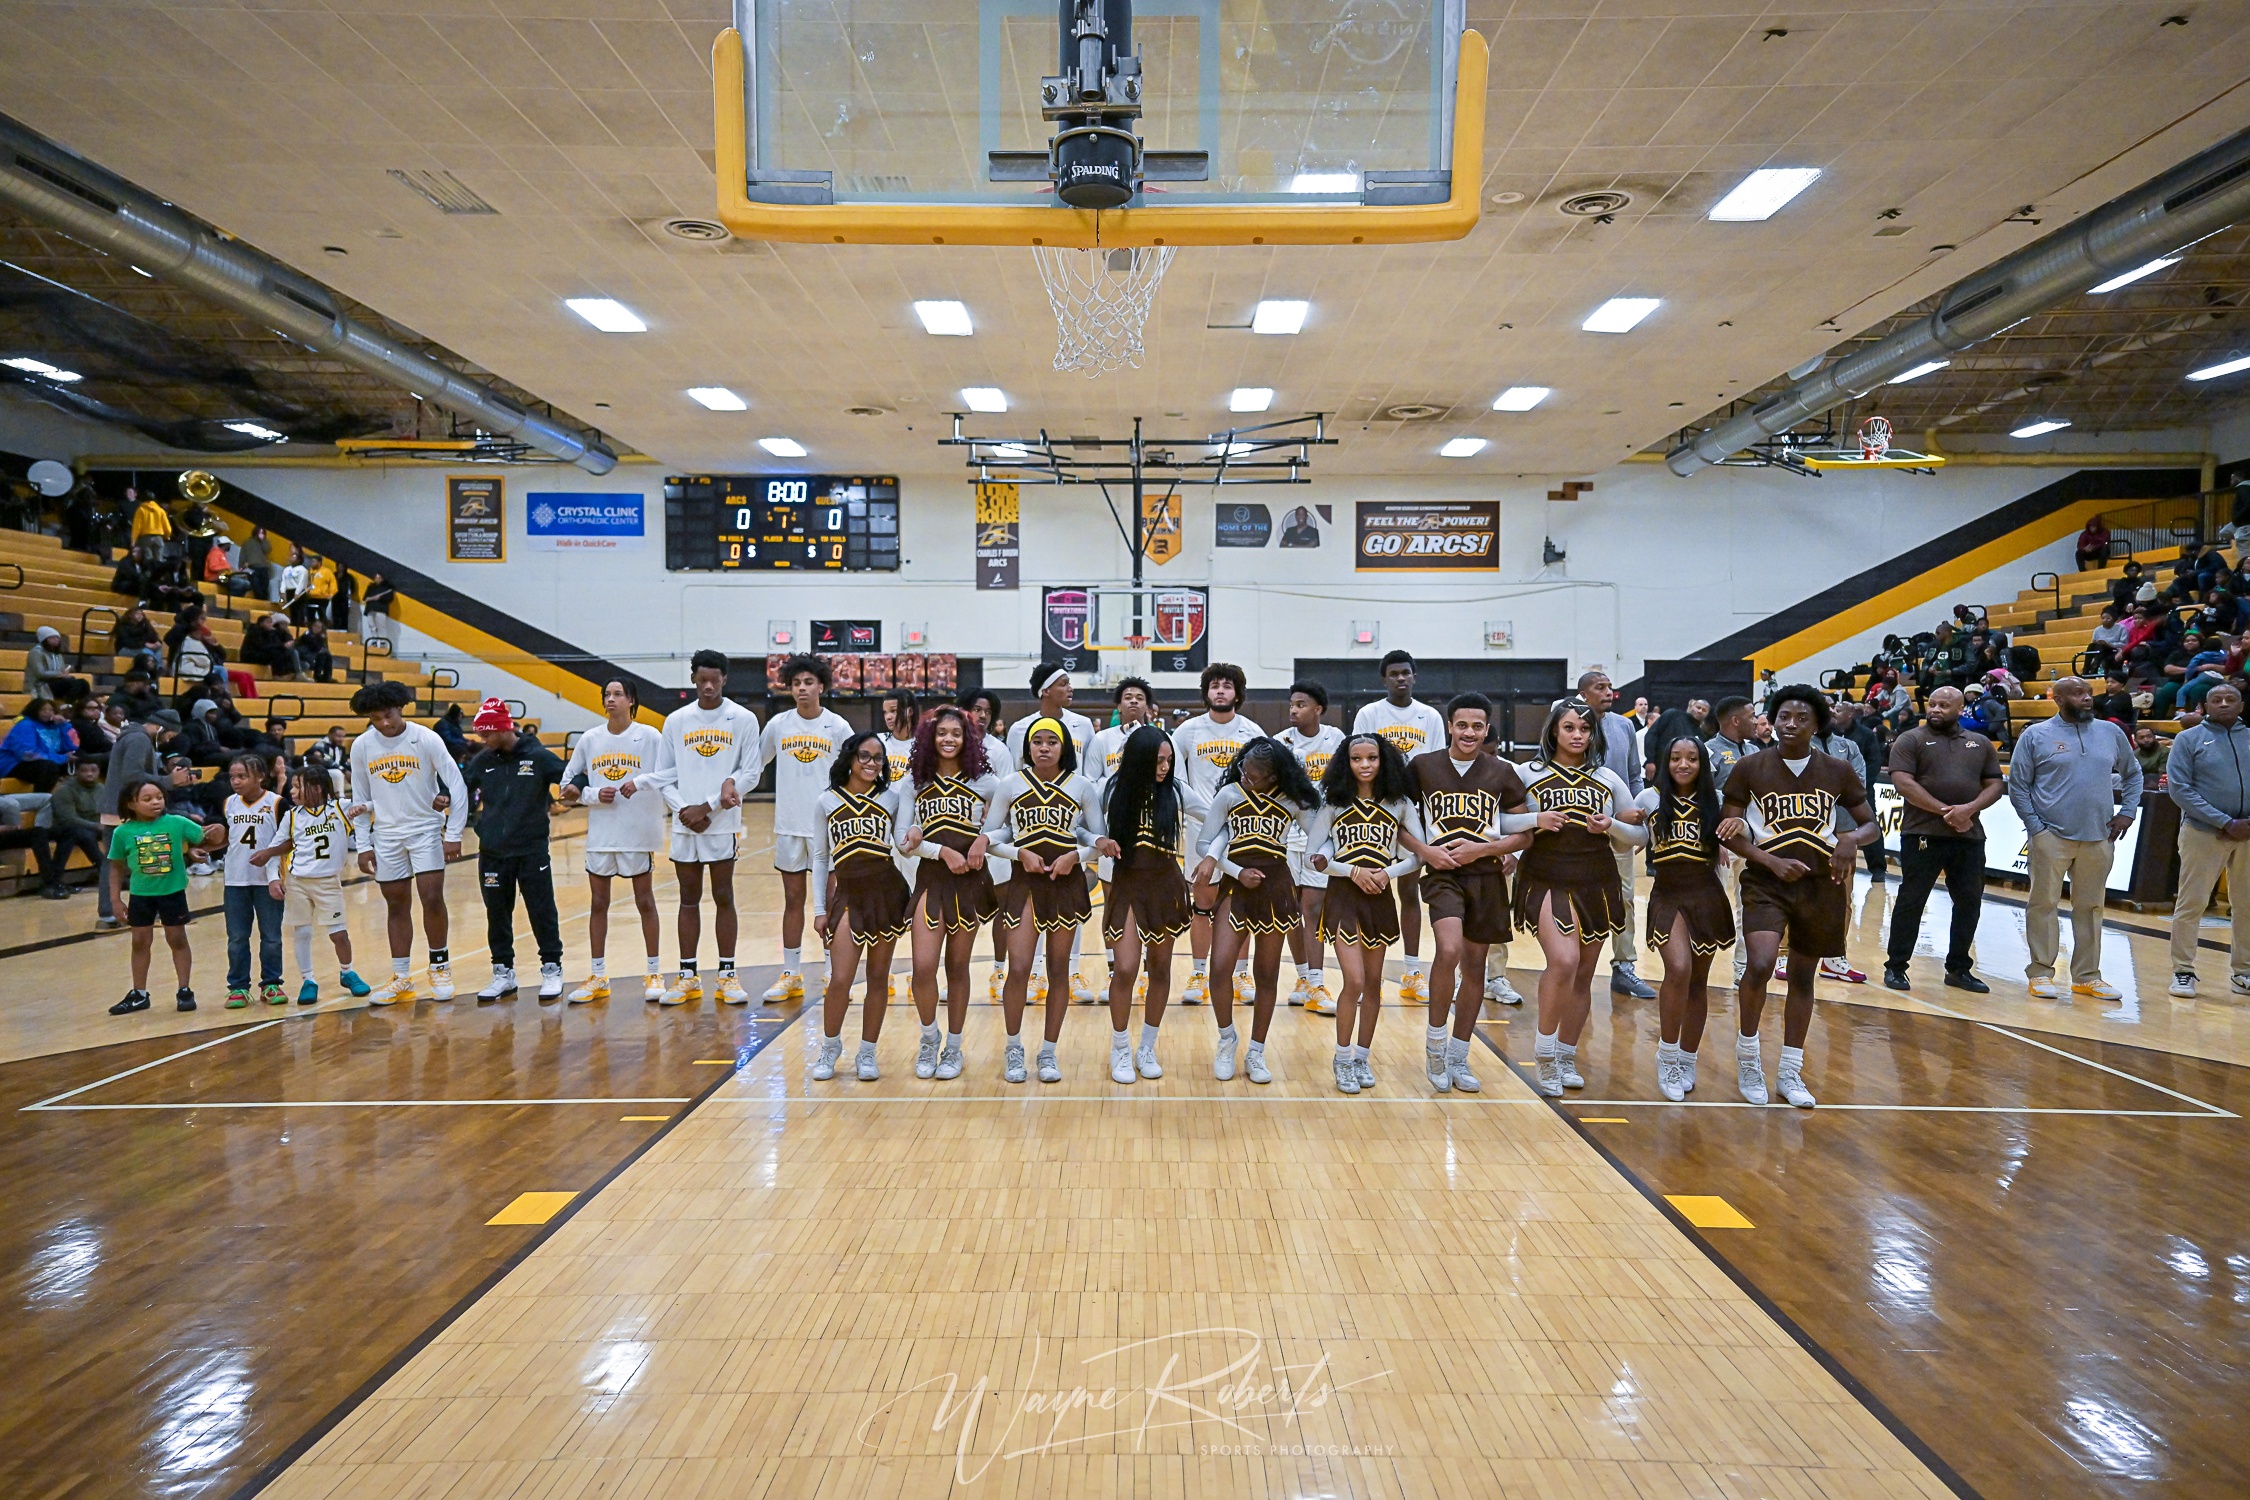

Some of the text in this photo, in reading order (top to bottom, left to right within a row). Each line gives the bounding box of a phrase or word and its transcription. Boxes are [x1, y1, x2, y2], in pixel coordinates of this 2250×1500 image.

[1071, 164, 1119, 180] SPALDING
[725, 496, 747, 505] ARCS
[768, 481, 807, 502] 8:00
[557, 506, 639, 517] CRYSTAL CLINIC
[610, 517, 639, 525] CENTER
[736, 508, 751, 529] 0
[827, 508, 842, 530] 0
[976, 508, 1019, 523] HOUSE
[1365, 516, 1490, 526] FEEL THE POWER!
[1143, 517, 1180, 528] BRUH
[1218, 523, 1268, 531] HOME OF THE
[1364, 533, 1491, 554] GO ARCS!
[988, 559, 1008, 567] ARCS
[683, 729, 733, 747] BASKETBALL
[781, 735, 833, 753] BASKETBALL
[368, 755, 421, 775] BASKETBALL
[592, 753, 642, 771] BASKETBALL
[917, 794, 973, 822] BRUSH
[1428, 788, 1497, 828] BRUSH
[1538, 786, 1605, 814] BRUSH
[1761, 788, 1835, 828] BRUSH
[233, 814, 264, 825] BRUSH
[1015, 803, 1073, 834] BRUSH
[1230, 813, 1286, 842] BRUSH
[240, 825, 257, 850] 4
[304, 822, 336, 837] BRUSH
[830, 813, 887, 848] BRUSH
[1336, 822, 1395, 853] BRUSH
[314, 835, 331, 860] 2
